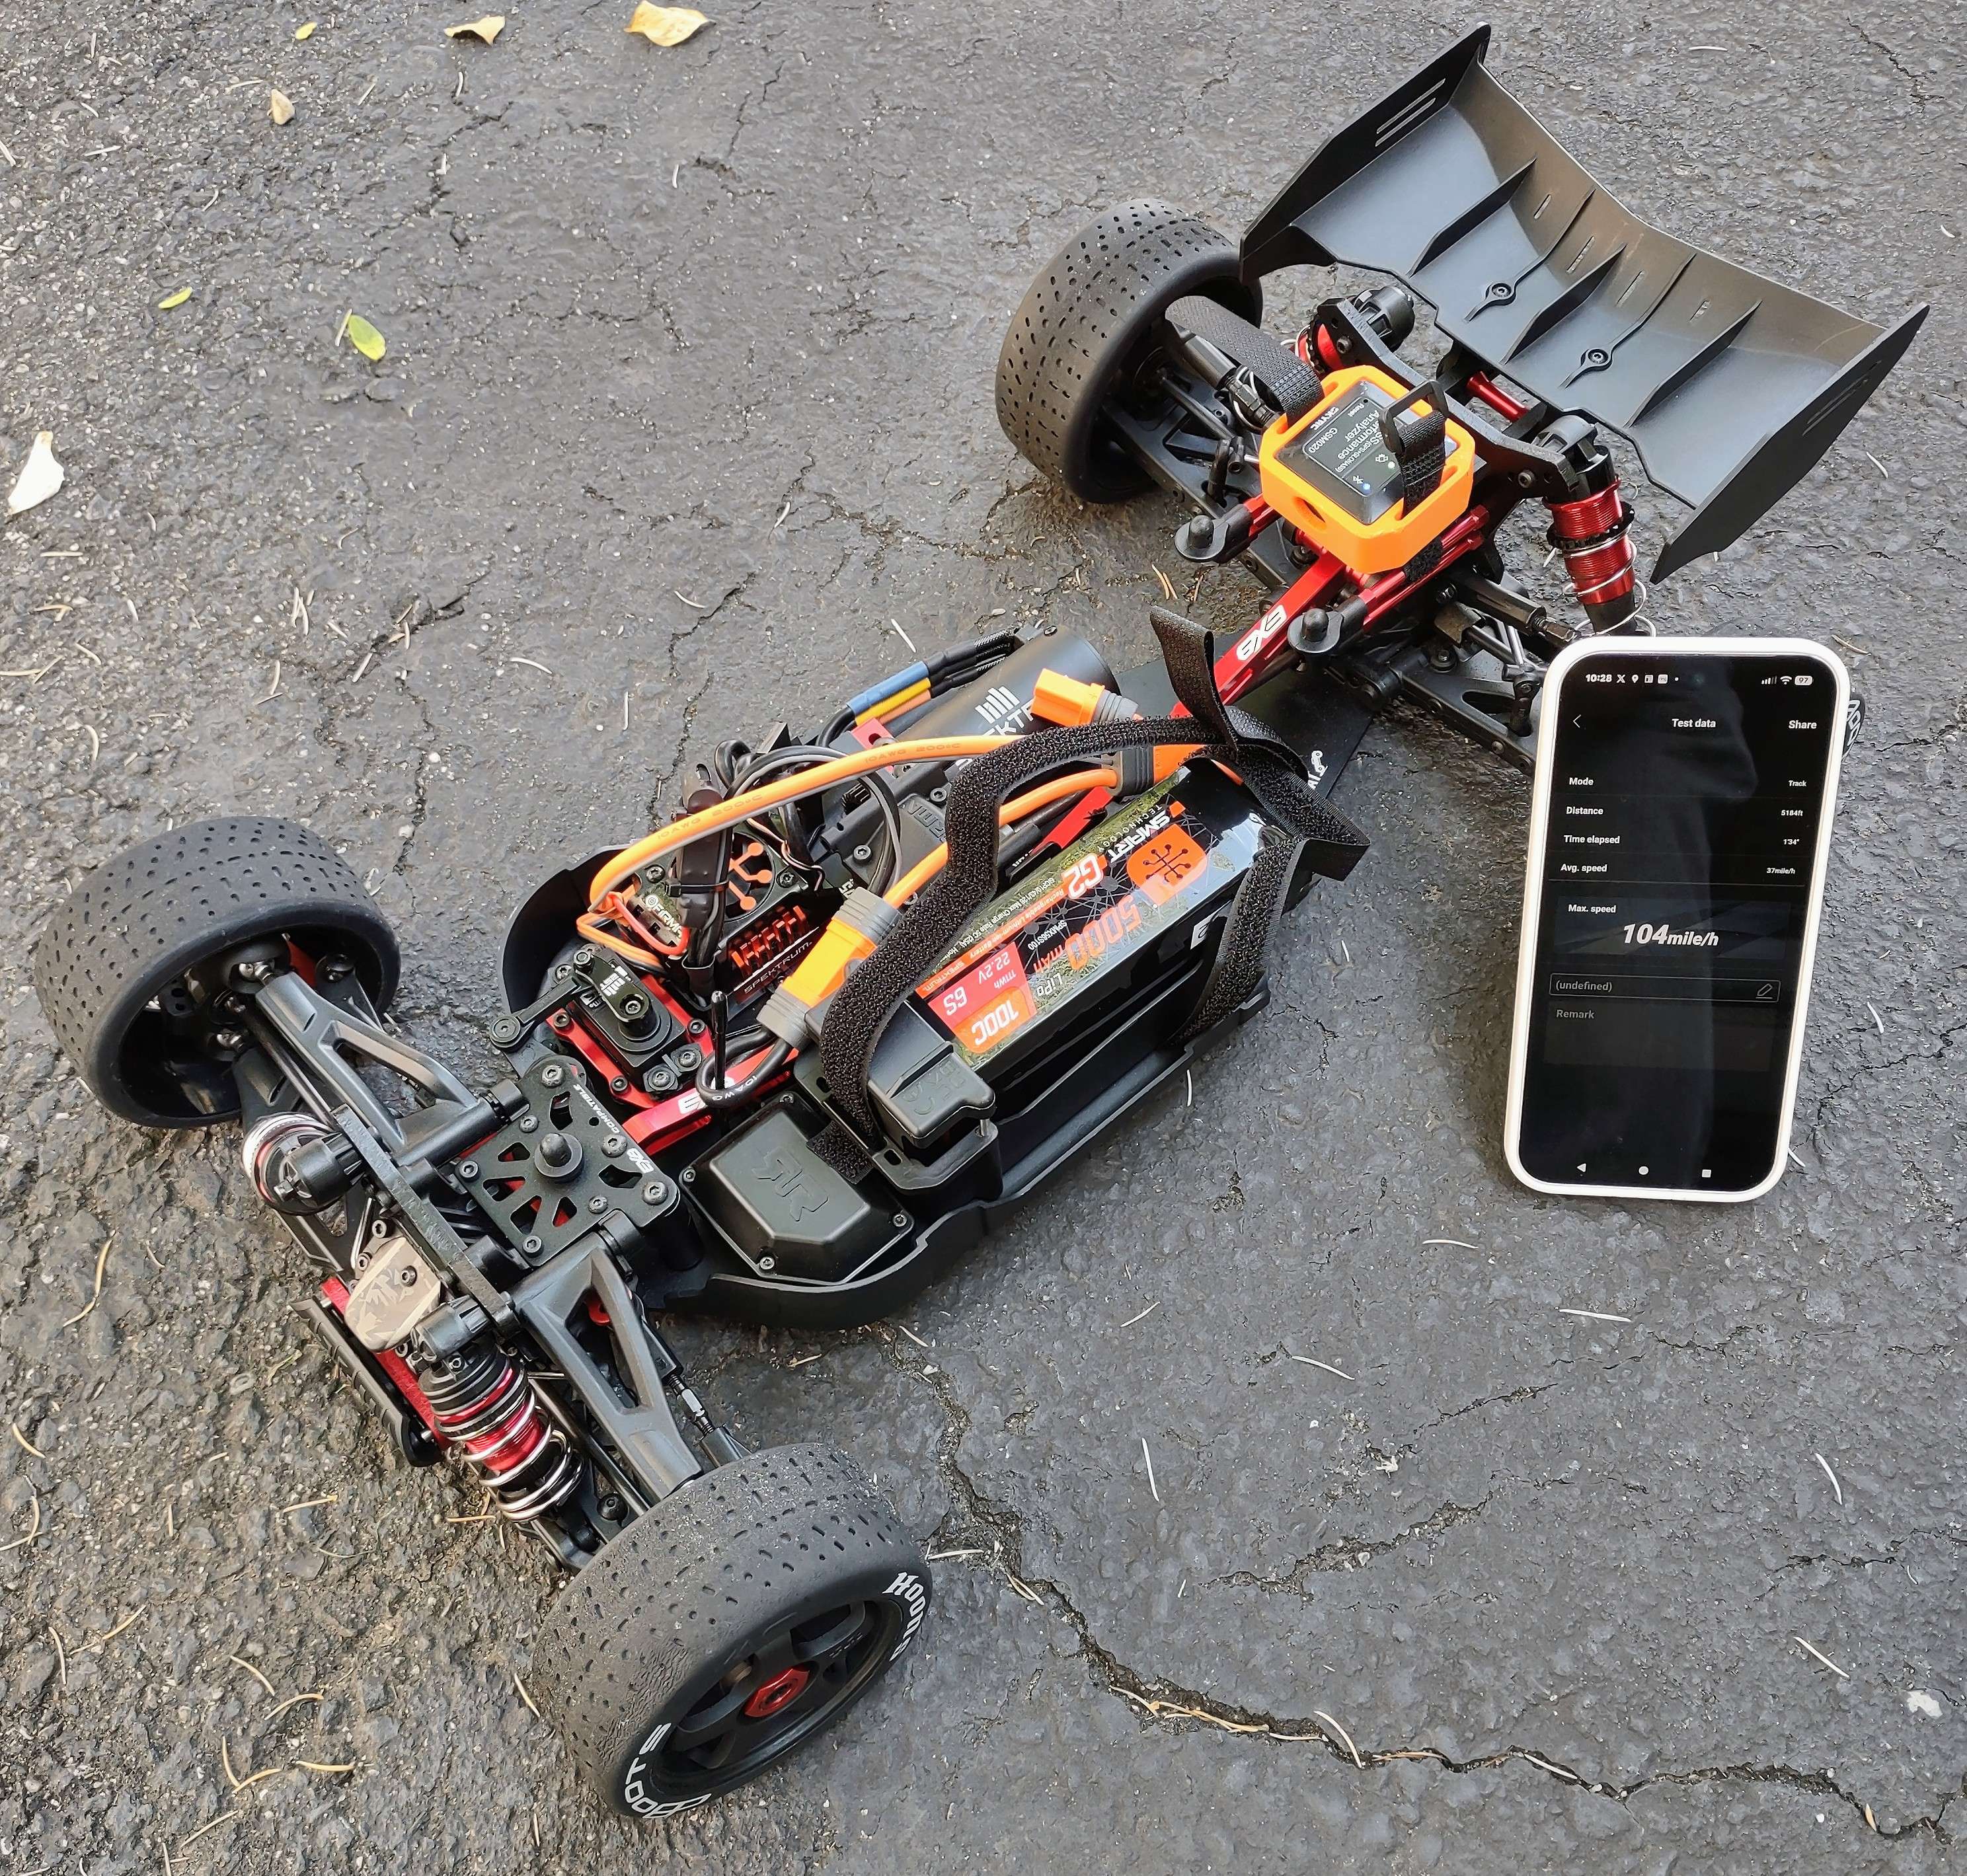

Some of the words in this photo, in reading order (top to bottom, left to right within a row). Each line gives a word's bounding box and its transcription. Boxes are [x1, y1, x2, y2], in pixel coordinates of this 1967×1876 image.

[1310, 406, 1339, 430] SKYRC
[1345, 410, 1379, 442] Analyzer
[1309, 428, 1338, 453] GSM020
[1338, 420, 1379, 459] rformance
[1586, 674, 1612, 683] 10:28
[1672, 719, 1693, 728] Test
[1695, 719, 1716, 728] data
[1789, 720, 1817, 729] Share
[1569, 777, 1594, 786] Mode
[1566, 806, 1603, 815] Distance
[1097, 804, 1162, 850] TECHNOLOGY
[1108, 809, 1170, 863] SMART
[1586, 835, 1620, 845] elapsed
[1062, 853, 1103, 899] G2
[1561, 864, 1580, 873] Avg.
[1582, 864, 1607, 874] speed
[1568, 905, 1588, 913] Max.
[1591, 905, 1616, 914] speed
[744, 942, 809, 993] SPEKTRUM
[978, 951, 1011, 985] 22.2V
[1036, 973, 1063, 996] LiPo
[1556, 981, 1613, 993] (undefined)
[943, 986, 968, 1016] 6S
[971, 999, 1019, 1045] 100C
[1556, 1009, 1595, 1019] Remark
[574, 1084, 620, 1133] COMPATIBLE
